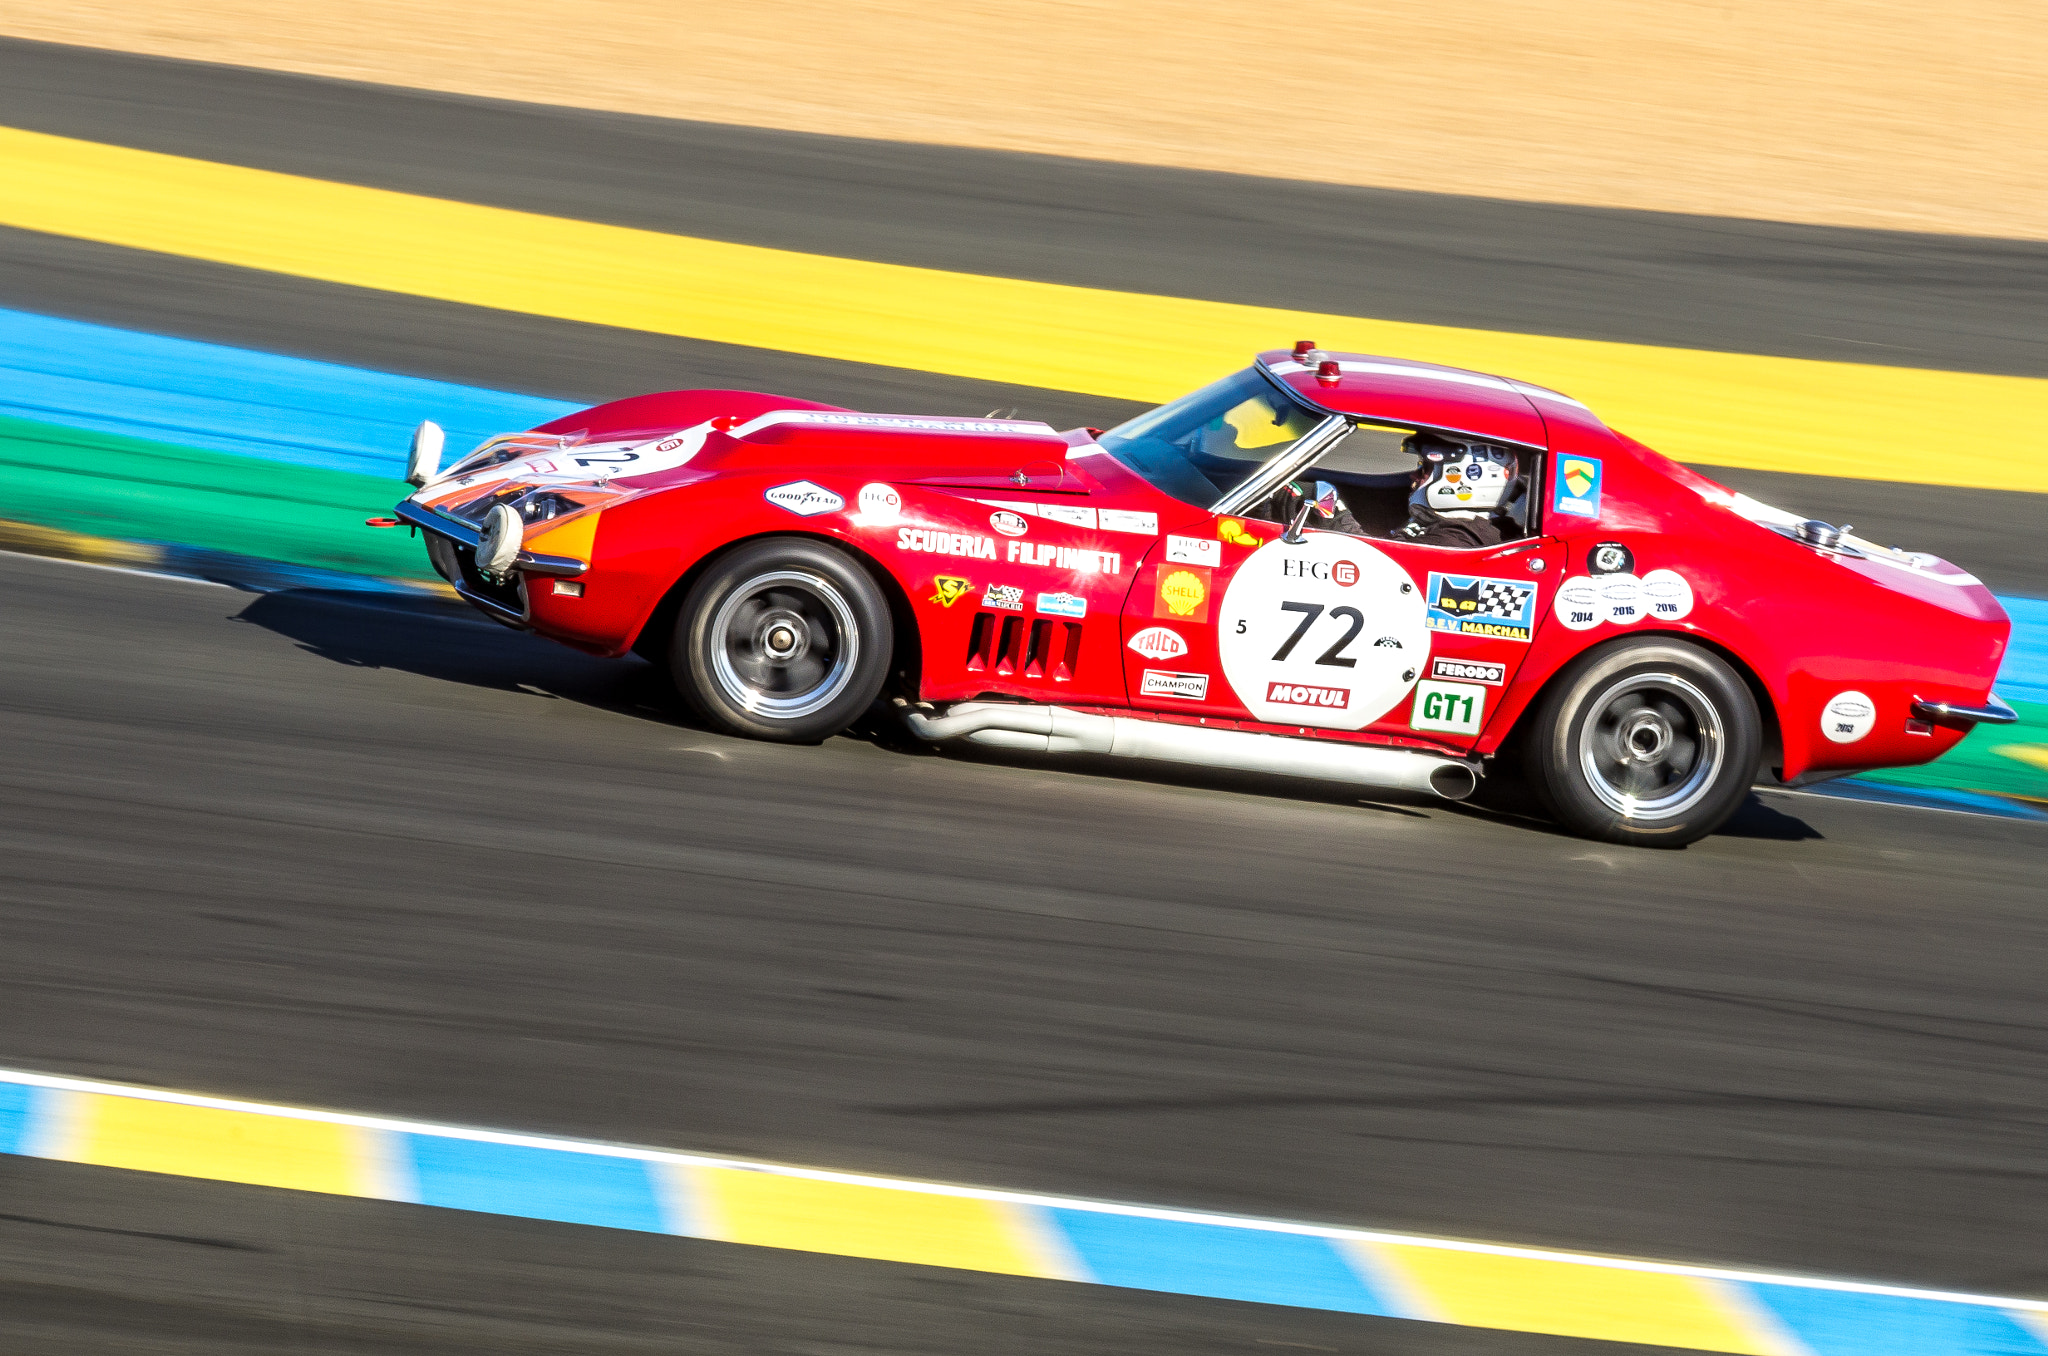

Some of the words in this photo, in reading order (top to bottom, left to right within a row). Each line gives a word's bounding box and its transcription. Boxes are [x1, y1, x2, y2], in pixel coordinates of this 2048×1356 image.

[897, 528, 997, 560] SCUDERIA
[1283, 558, 1329, 580] EFG
[1166, 585, 1200, 599] SHELL
[1570, 612, 1594, 623] 2014
[1613, 606, 1635, 616] 2015
[1656, 603, 1678, 613] 2016
[1236, 619, 1247, 634] 5
[1271, 601, 1364, 668] 72
[1426, 617, 1460, 631] S.E.V.
[1461, 621, 1528, 639] MARCHAL
[1137, 631, 1179, 653] TRICO
[1437, 663, 1499, 680] FERODO
[1147, 679, 1203, 691] CHAMPION
[1269, 685, 1345, 707] MOTUL
[1423, 692, 1474, 723] GT1
